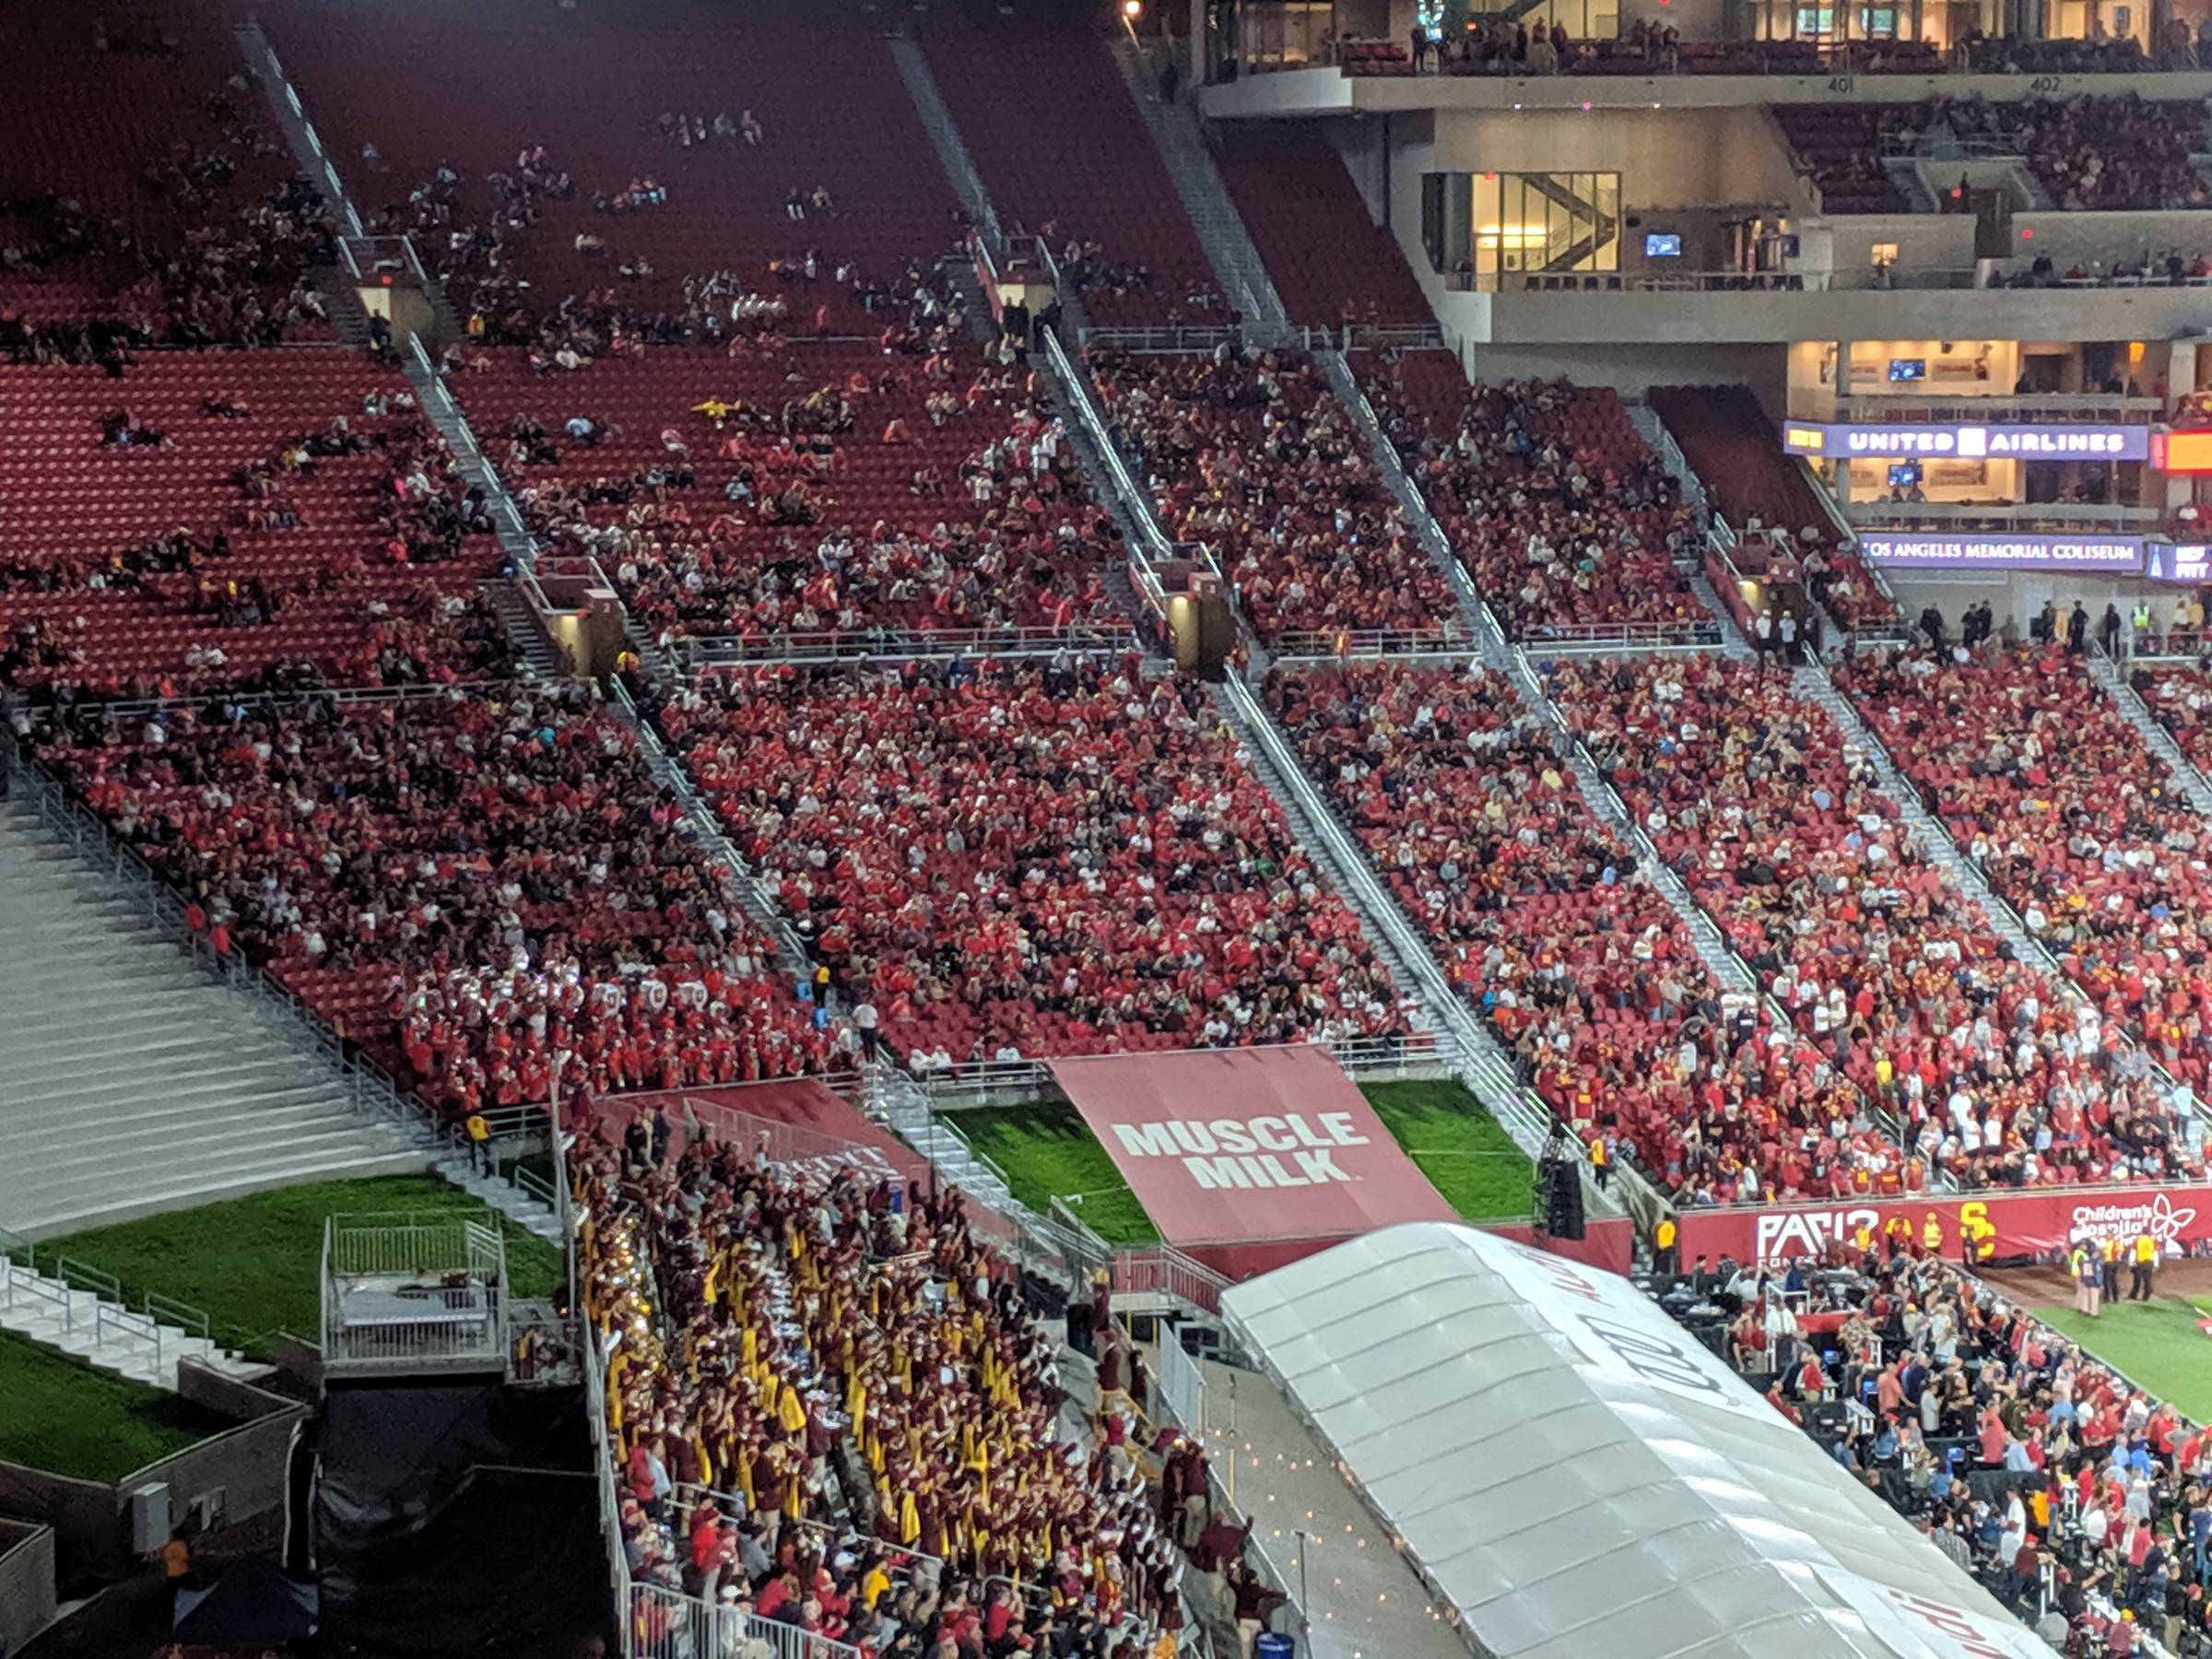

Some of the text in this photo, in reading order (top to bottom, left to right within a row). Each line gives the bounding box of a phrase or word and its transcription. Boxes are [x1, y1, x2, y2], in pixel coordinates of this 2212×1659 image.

[1829, 77, 1853, 92] 401
[2030, 76, 2061, 92] 402
[1849, 432, 2124, 453] UNITED AIRLINES
[1894, 543, 1961, 559] ANGELES
[1965, 544, 2050, 559] MEMORIAL
[2052, 545, 2135, 560] COLISEUM
[1110, 1112, 1371, 1157] MUSCLE
[1182, 1148, 1352, 1189] MILK
[2072, 1204, 2153, 1222] Children's
